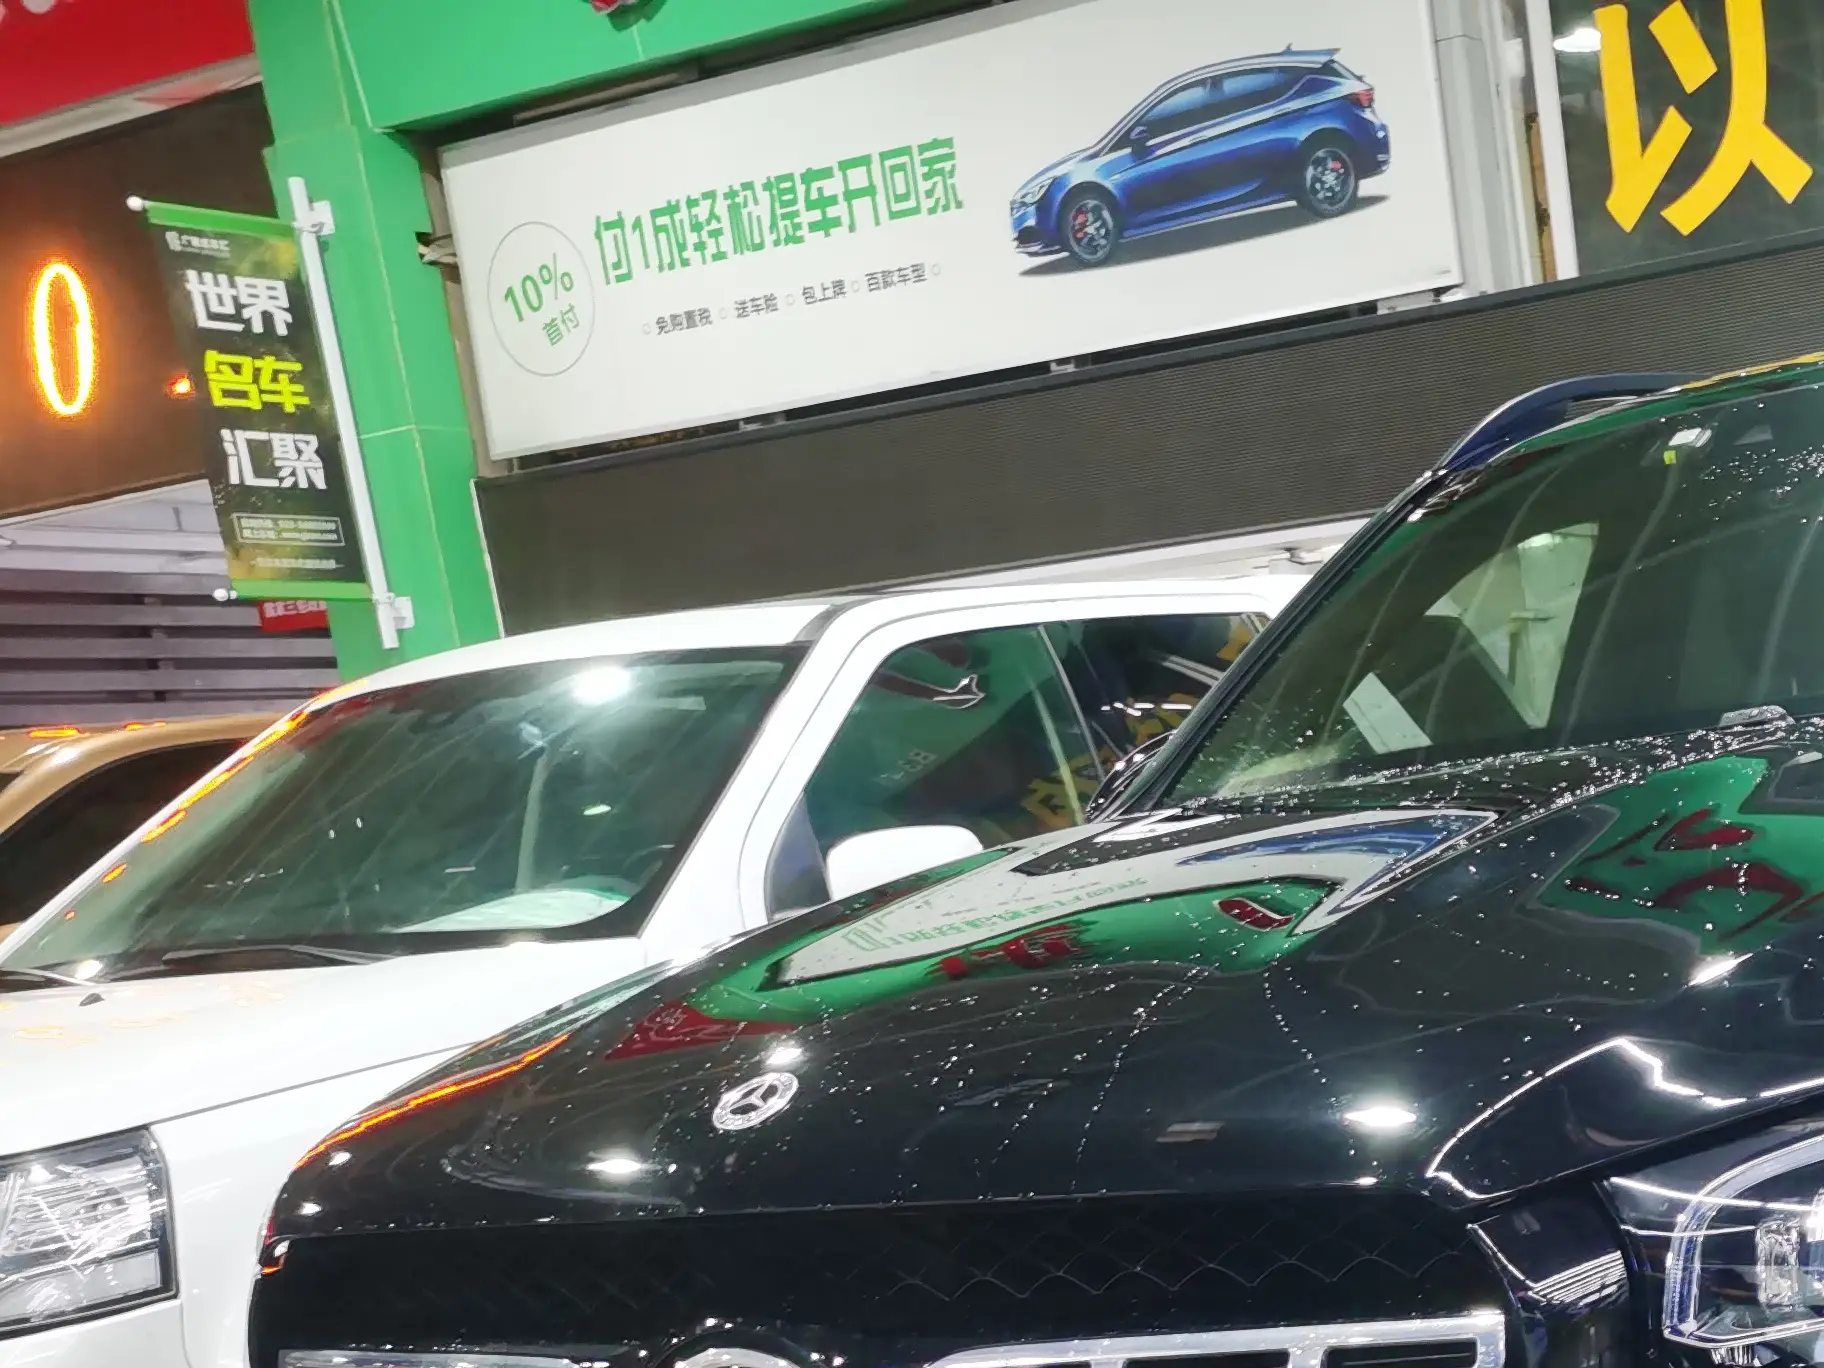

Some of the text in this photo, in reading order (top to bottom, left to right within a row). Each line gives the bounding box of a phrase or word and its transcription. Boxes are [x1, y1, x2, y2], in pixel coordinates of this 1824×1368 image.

[594, 137, 964, 285] 付1成轻松提车开回家
[186, 269, 293, 336] 世界
[504, 252, 574, 322] 10%
[542, 303, 580, 346] 首付
[204, 350, 310, 413] 名车
[221, 428, 328, 490] 汇聚
